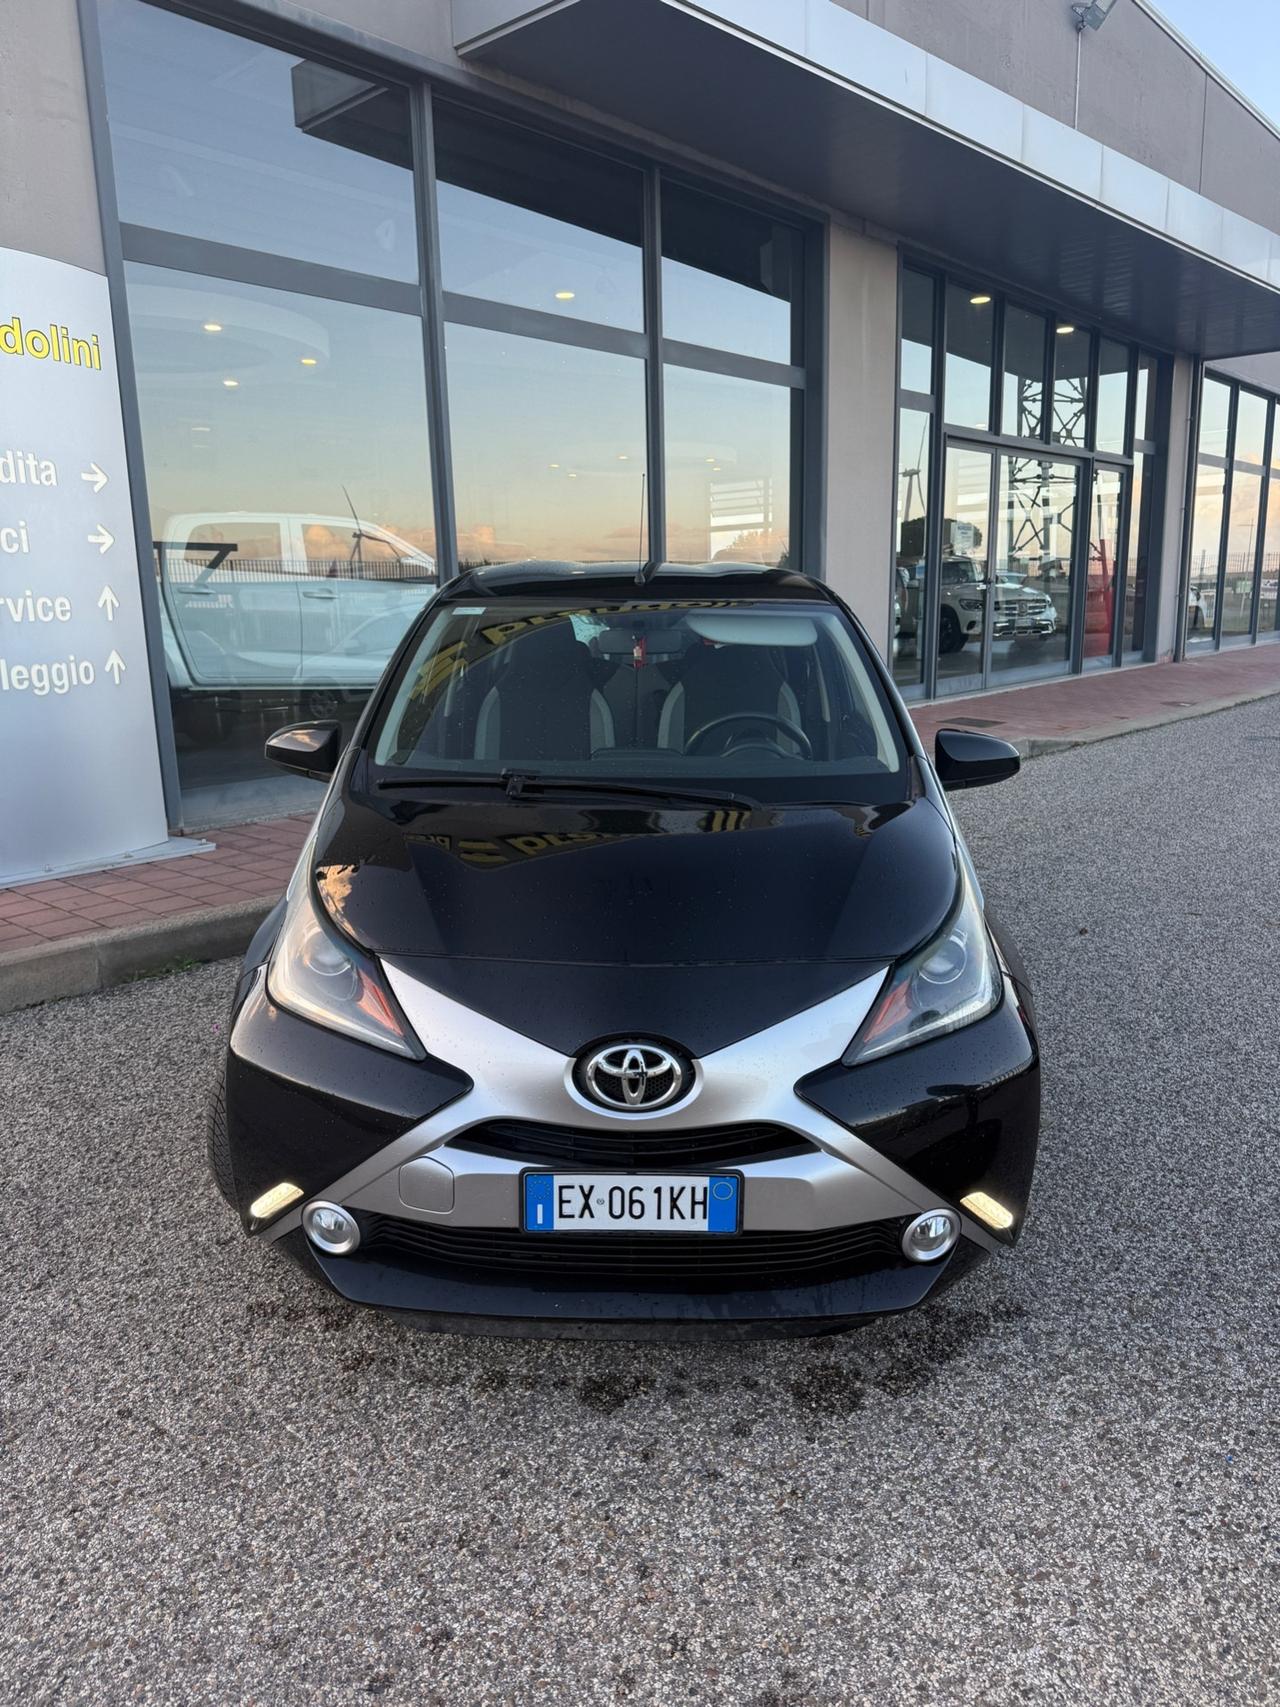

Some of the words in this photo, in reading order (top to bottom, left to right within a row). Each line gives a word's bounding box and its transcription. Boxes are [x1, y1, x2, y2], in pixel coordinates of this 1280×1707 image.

[0, 316, 101, 370] dolini
[0, 449, 57, 486] dita
[0, 654, 95, 696] leggio
